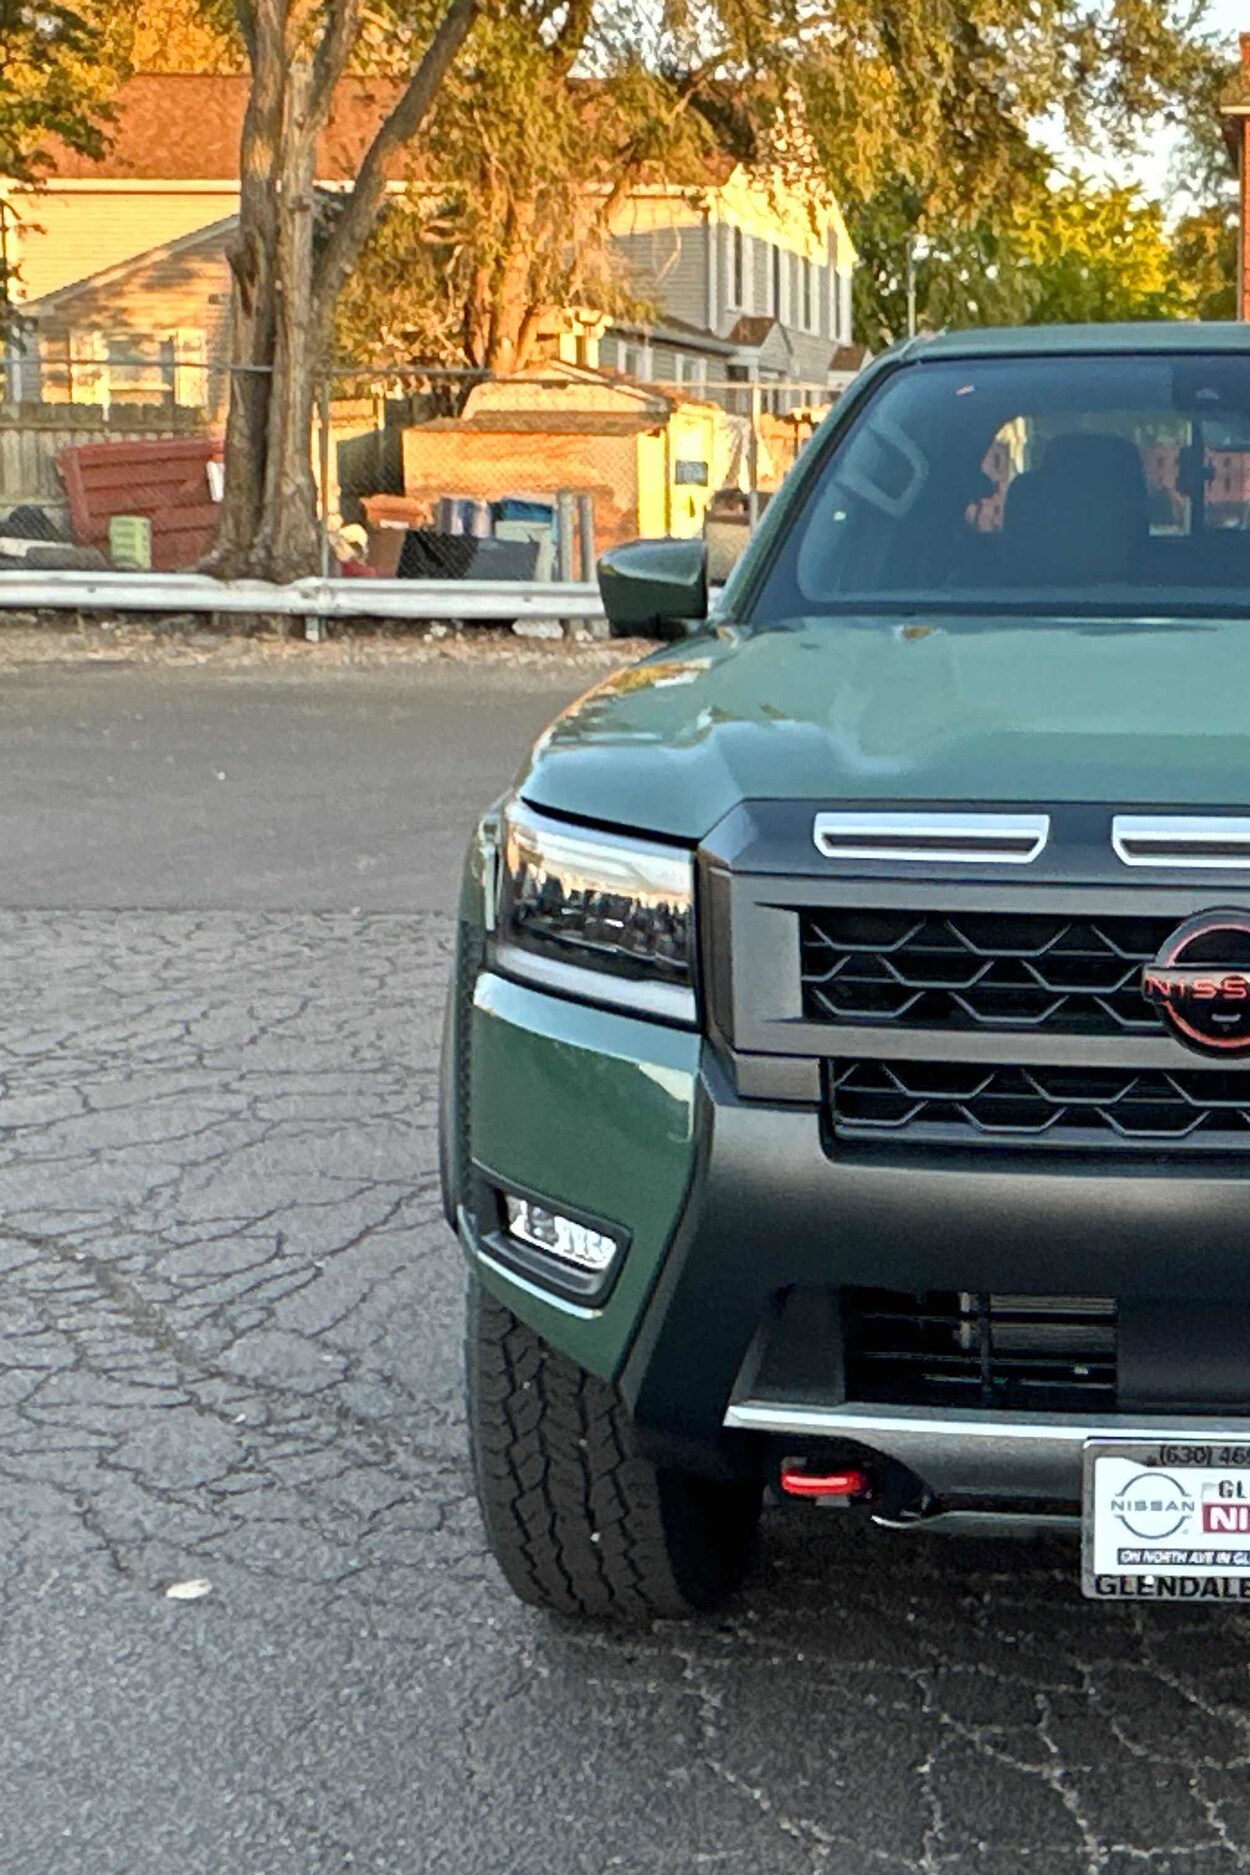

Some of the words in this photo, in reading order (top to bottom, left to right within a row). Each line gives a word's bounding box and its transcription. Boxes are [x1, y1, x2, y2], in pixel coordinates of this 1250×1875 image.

[1159, 1444, 1213, 1465] (630)
[1110, 1500, 1195, 1512] NISSAN
[1142, 1550, 1188, 1564] NORTH
